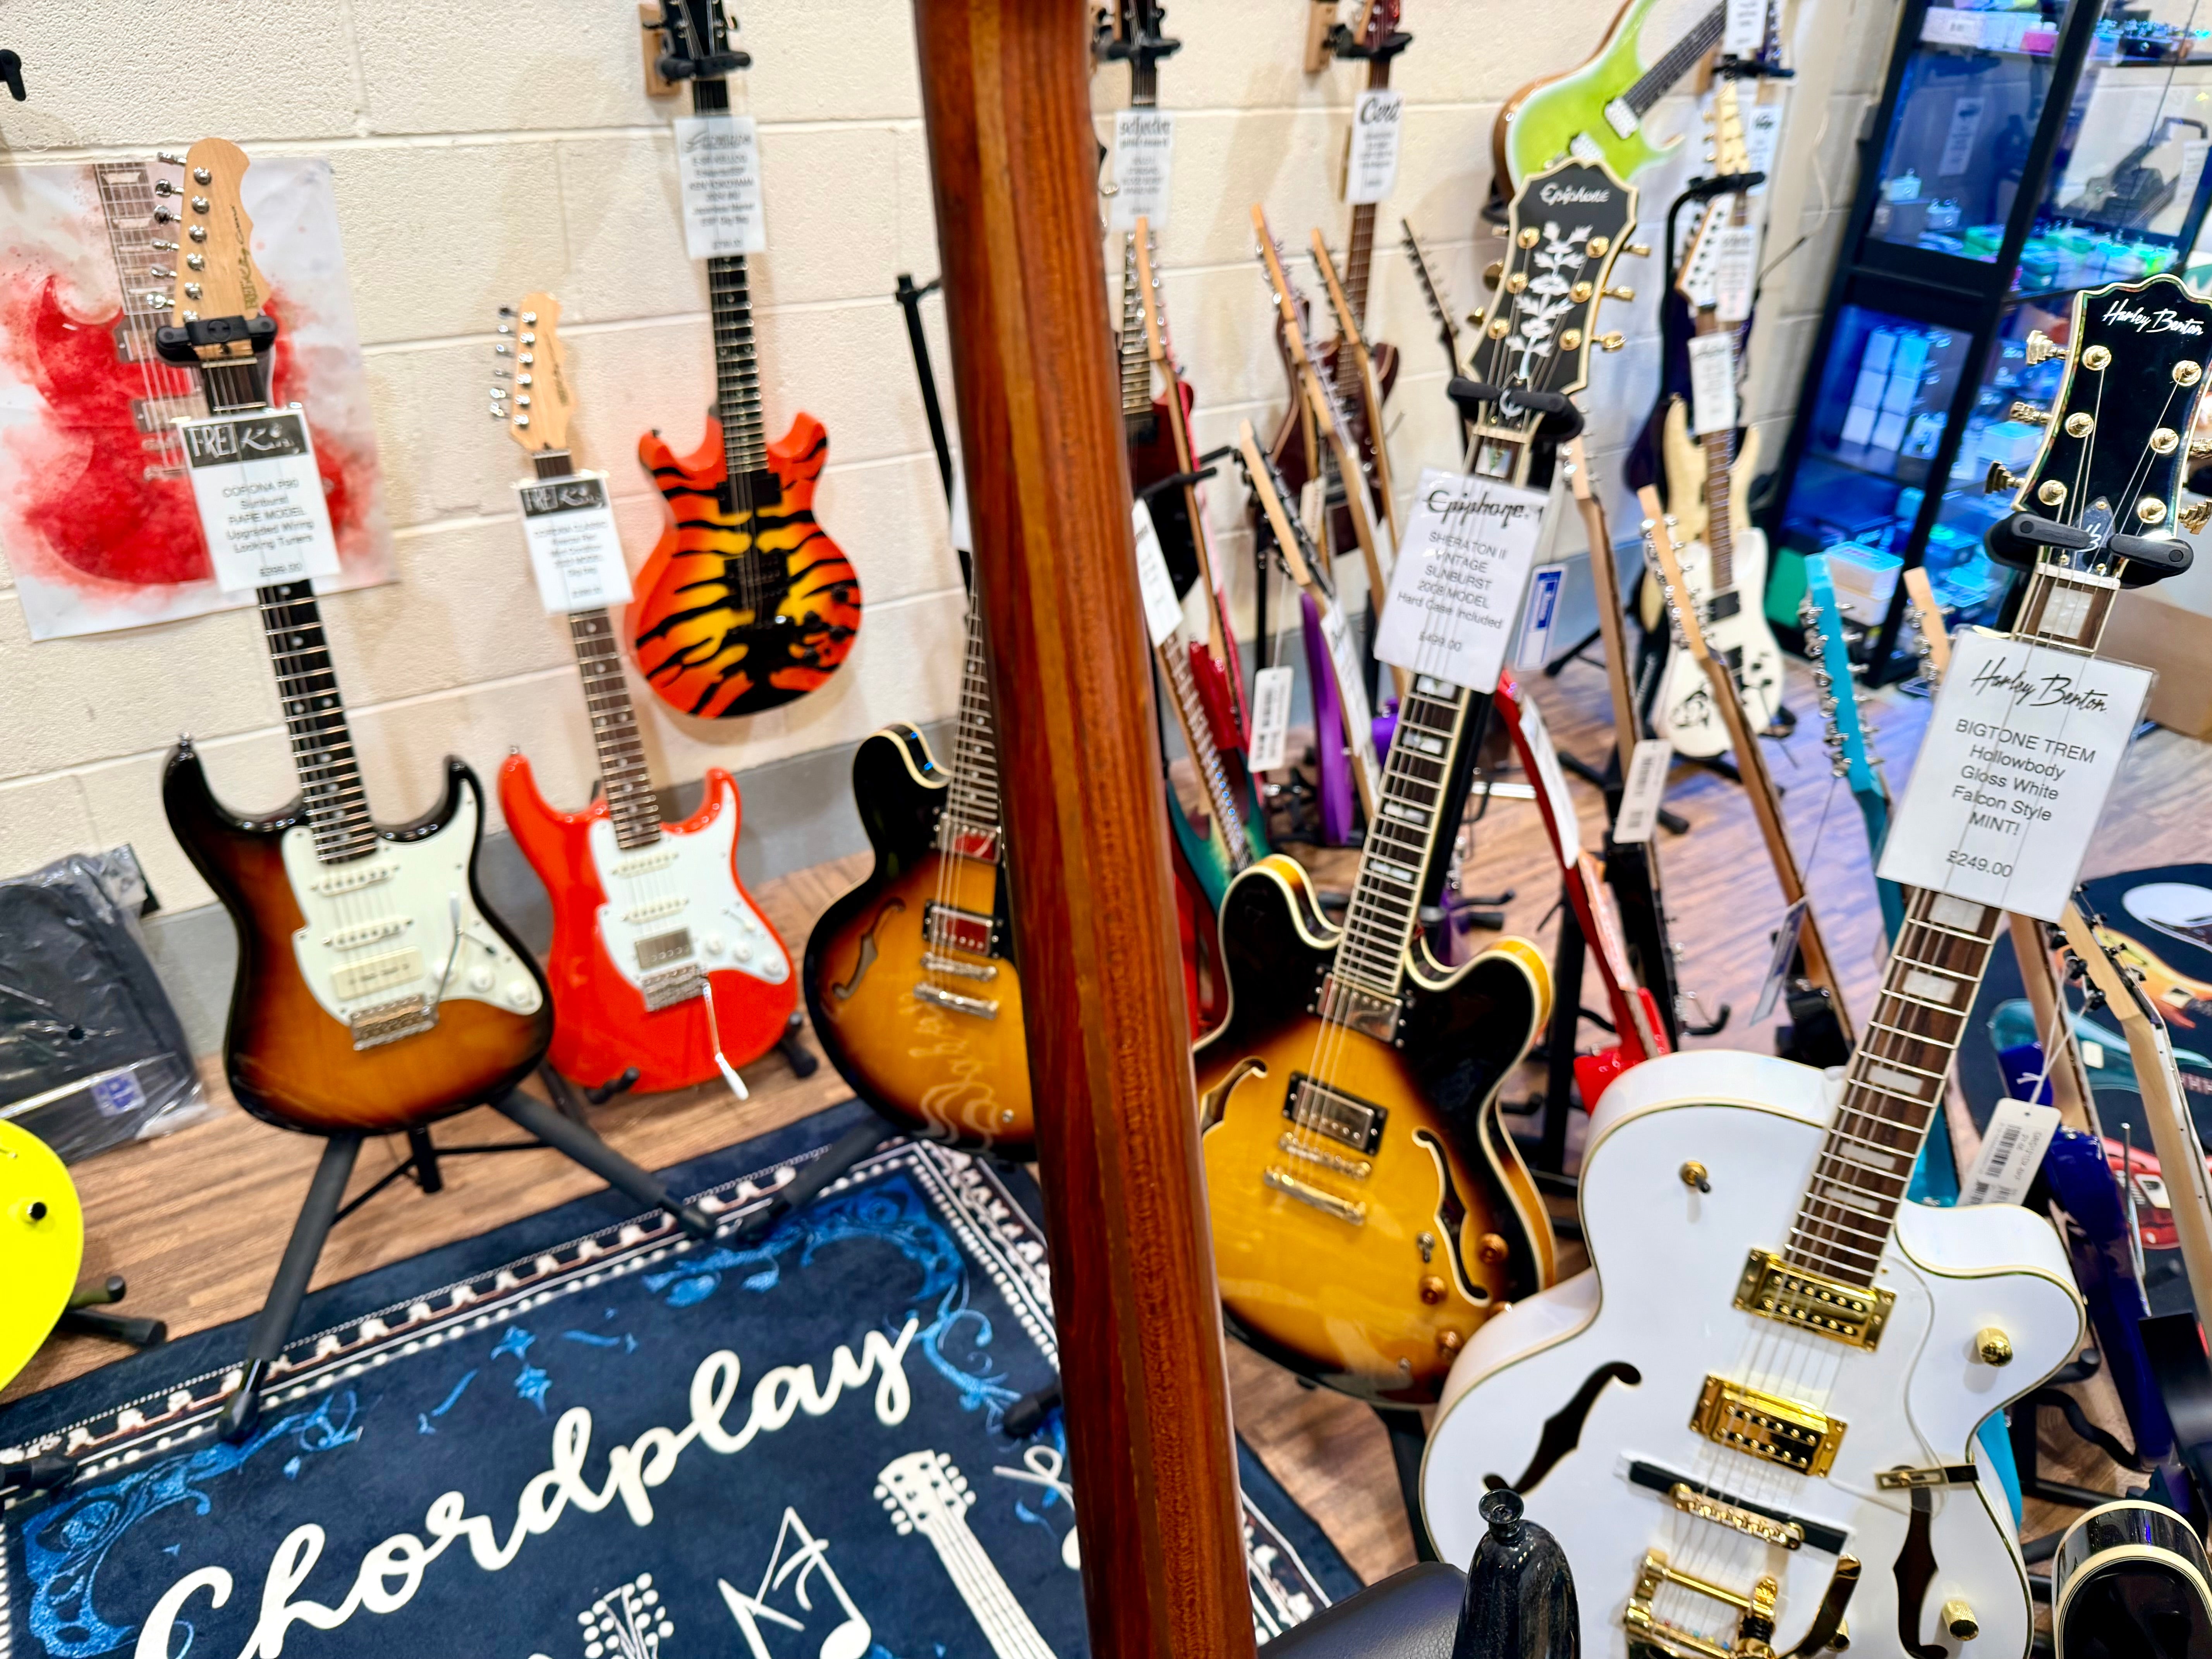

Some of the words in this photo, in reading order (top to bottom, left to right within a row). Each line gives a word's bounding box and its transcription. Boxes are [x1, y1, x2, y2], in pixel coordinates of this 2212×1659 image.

[1539, 182, 1611, 206] Epiphone
[2102, 298, 2151, 332] Harley
[2146, 308, 2204, 335] Benton
[264, 507, 307, 520] MODEL
[226, 525, 280, 541] Upgraded
[281, 520, 315, 533] Wiring
[276, 534, 313, 547] Tuners
[1429, 531, 1496, 558] SHERATON
[1435, 550, 1488, 573] VINTAGE
[1425, 565, 1492, 590] SUNBURST
[1397, 592, 1423, 607] Hard
[1425, 600, 1453, 616] Case
[1456, 606, 1503, 629] Included
[1446, 586, 1490, 609] MODEL
[1971, 657, 2037, 704] Harley
[2029, 674, 2108, 712] Benton
[1955, 719, 2040, 750] BIGTONE
[2043, 739, 2096, 764] TREM
[1969, 744, 2066, 781] Hollowbody
[1961, 765, 2006, 788] Gloss
[2014, 778, 2059, 800] White
[1953, 785, 2006, 811] Falcon
[2011, 800, 2052, 822] Style
[1969, 812, 2021, 836] MINT!
[1946, 850, 2013, 878] £249.00
[134, 1317, 919, 1659] Chordplay
